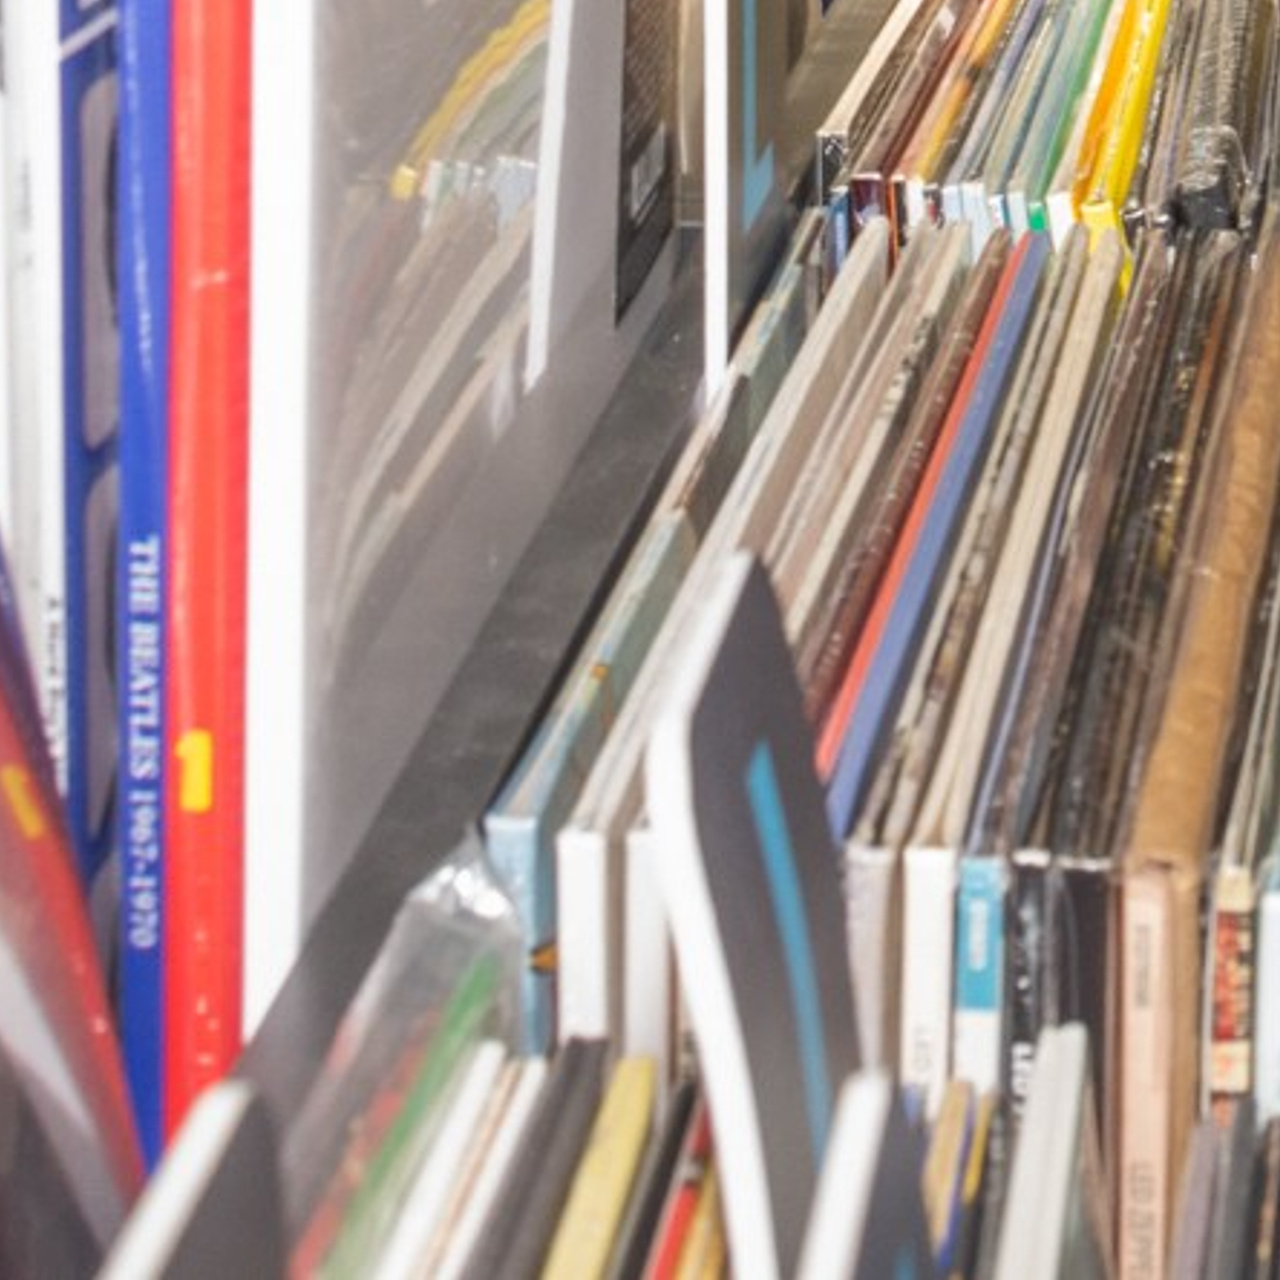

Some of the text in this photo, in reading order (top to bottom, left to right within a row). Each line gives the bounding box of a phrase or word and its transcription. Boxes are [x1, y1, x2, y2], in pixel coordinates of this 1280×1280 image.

[128, 534, 160, 949] THE BEATLES 1967-1970
